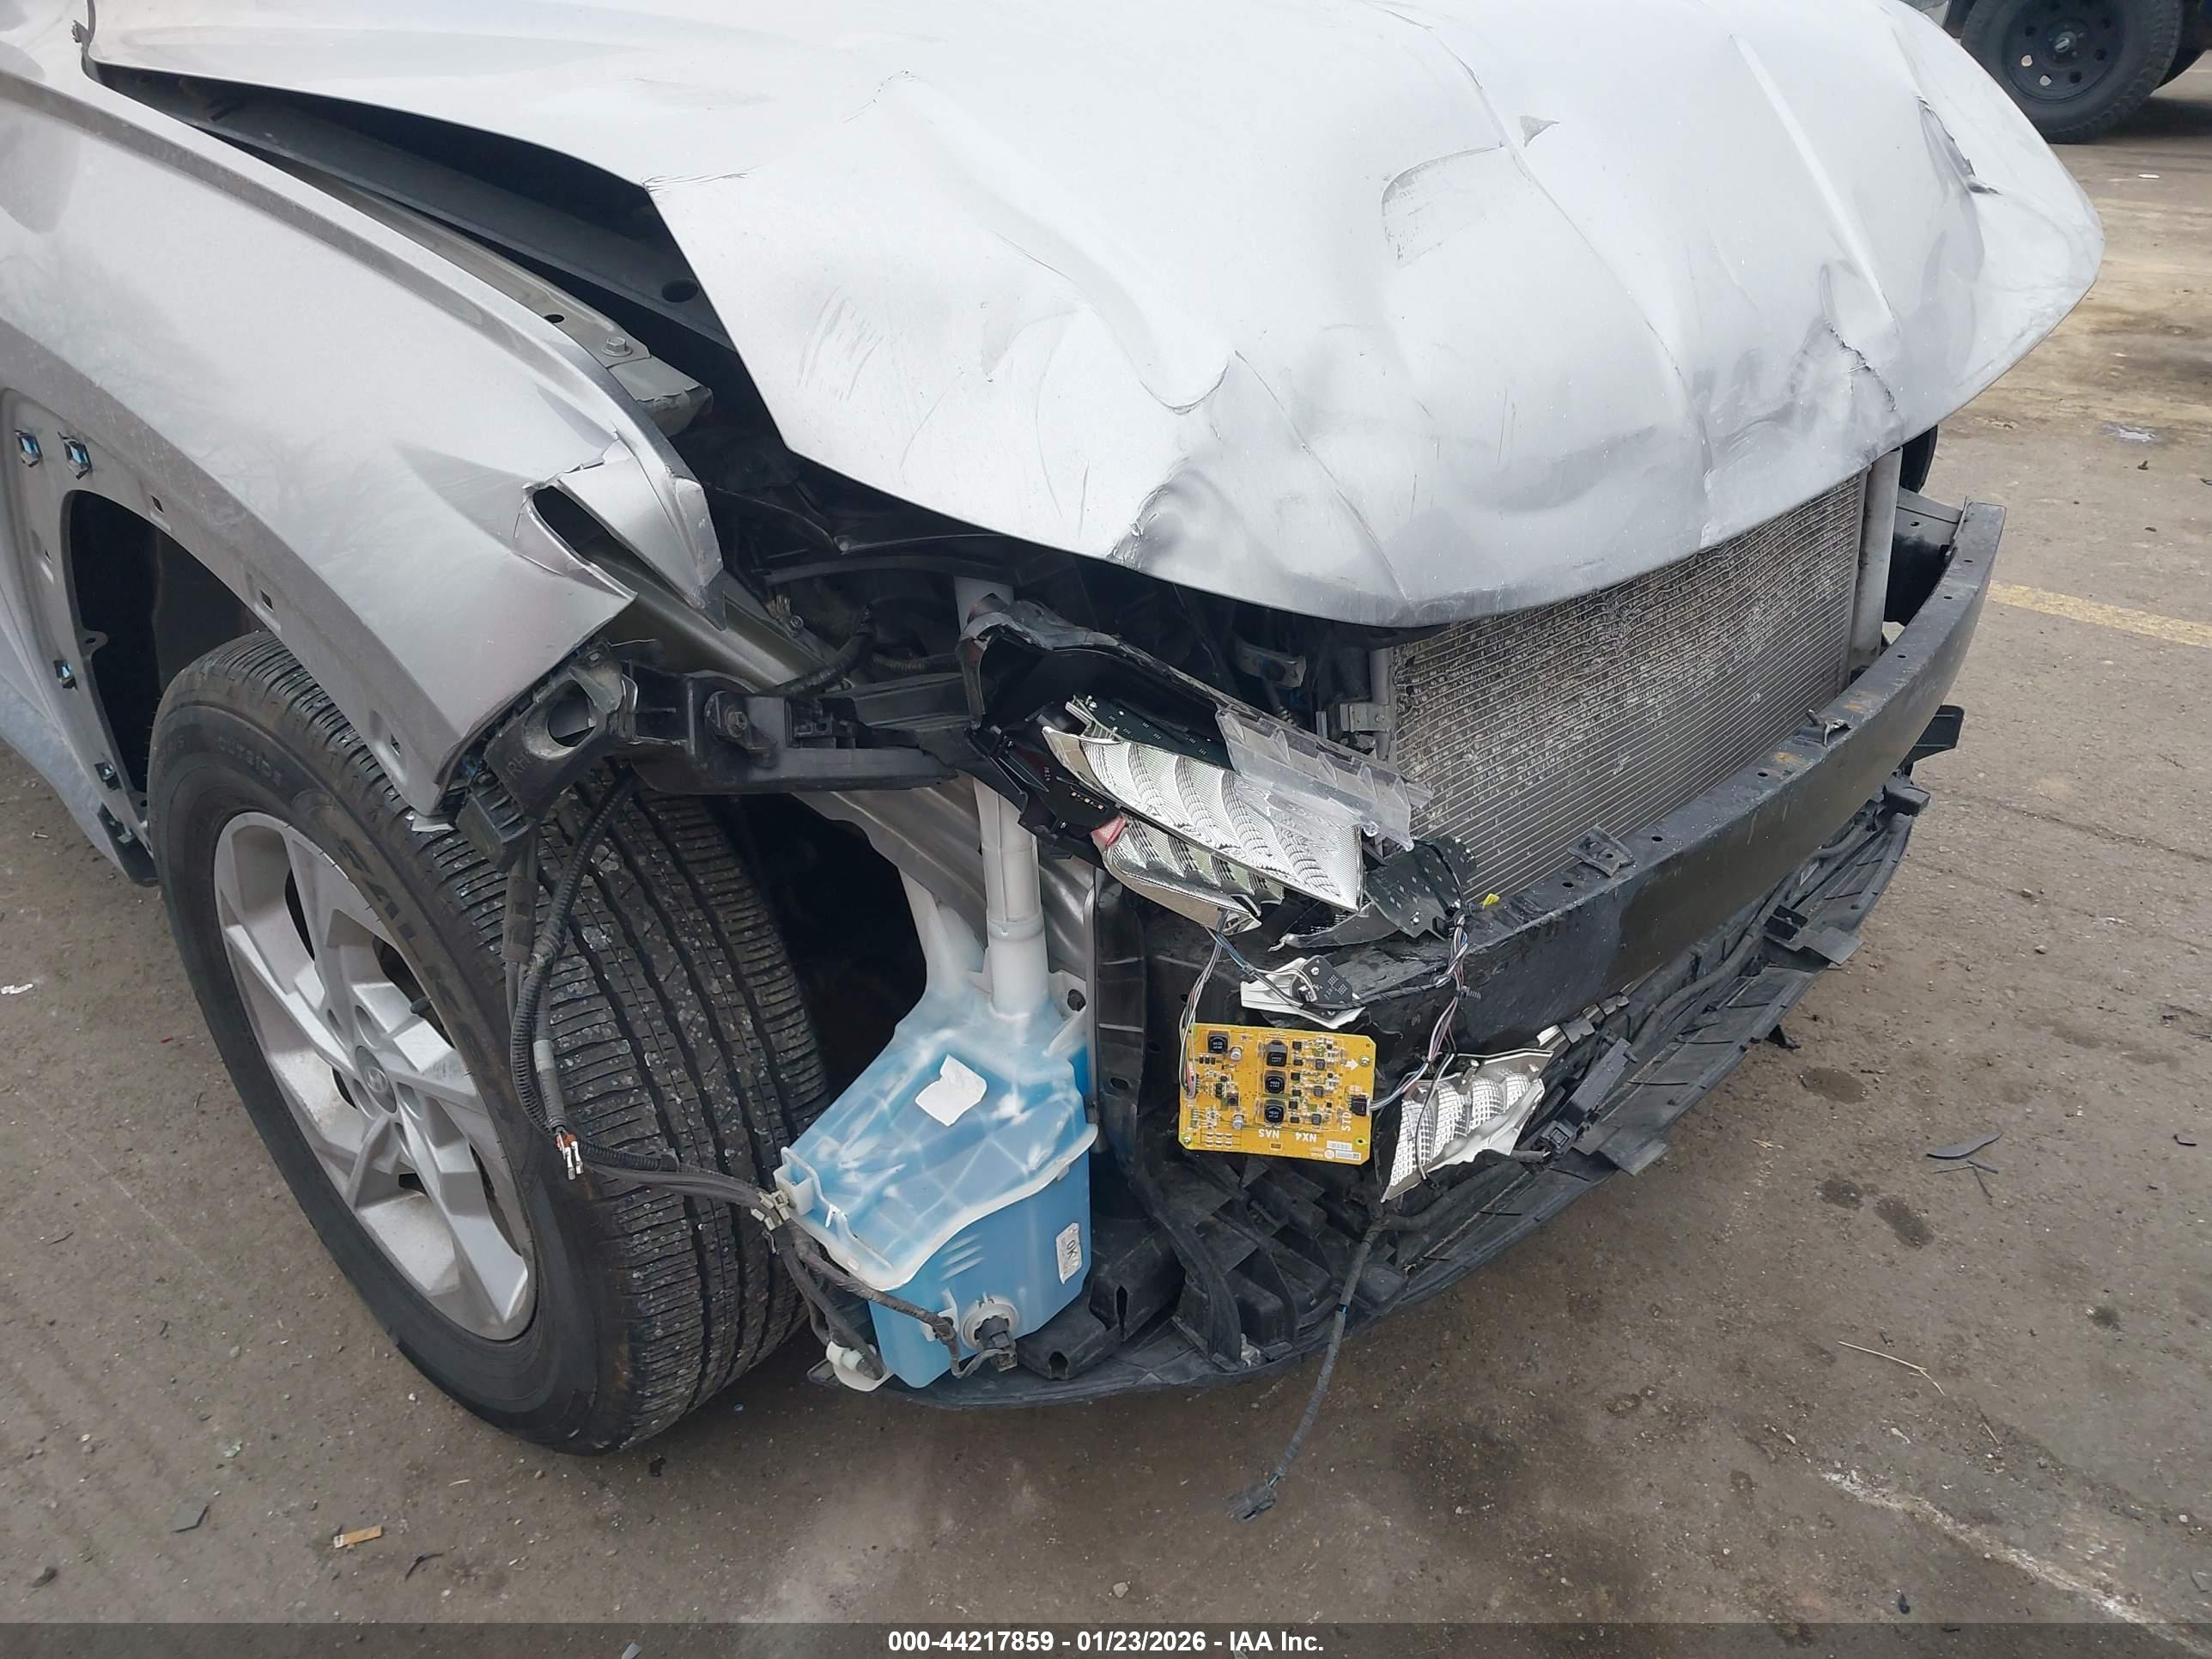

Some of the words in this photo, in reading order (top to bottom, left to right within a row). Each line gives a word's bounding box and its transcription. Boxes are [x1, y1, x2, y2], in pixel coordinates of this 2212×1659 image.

[1341, 1112, 1352, 1132] STD
[1259, 1128, 1279, 1139] NAS
[1295, 1131, 1317, 1142] NX4
[1066, 1240, 1078, 1260] OK
